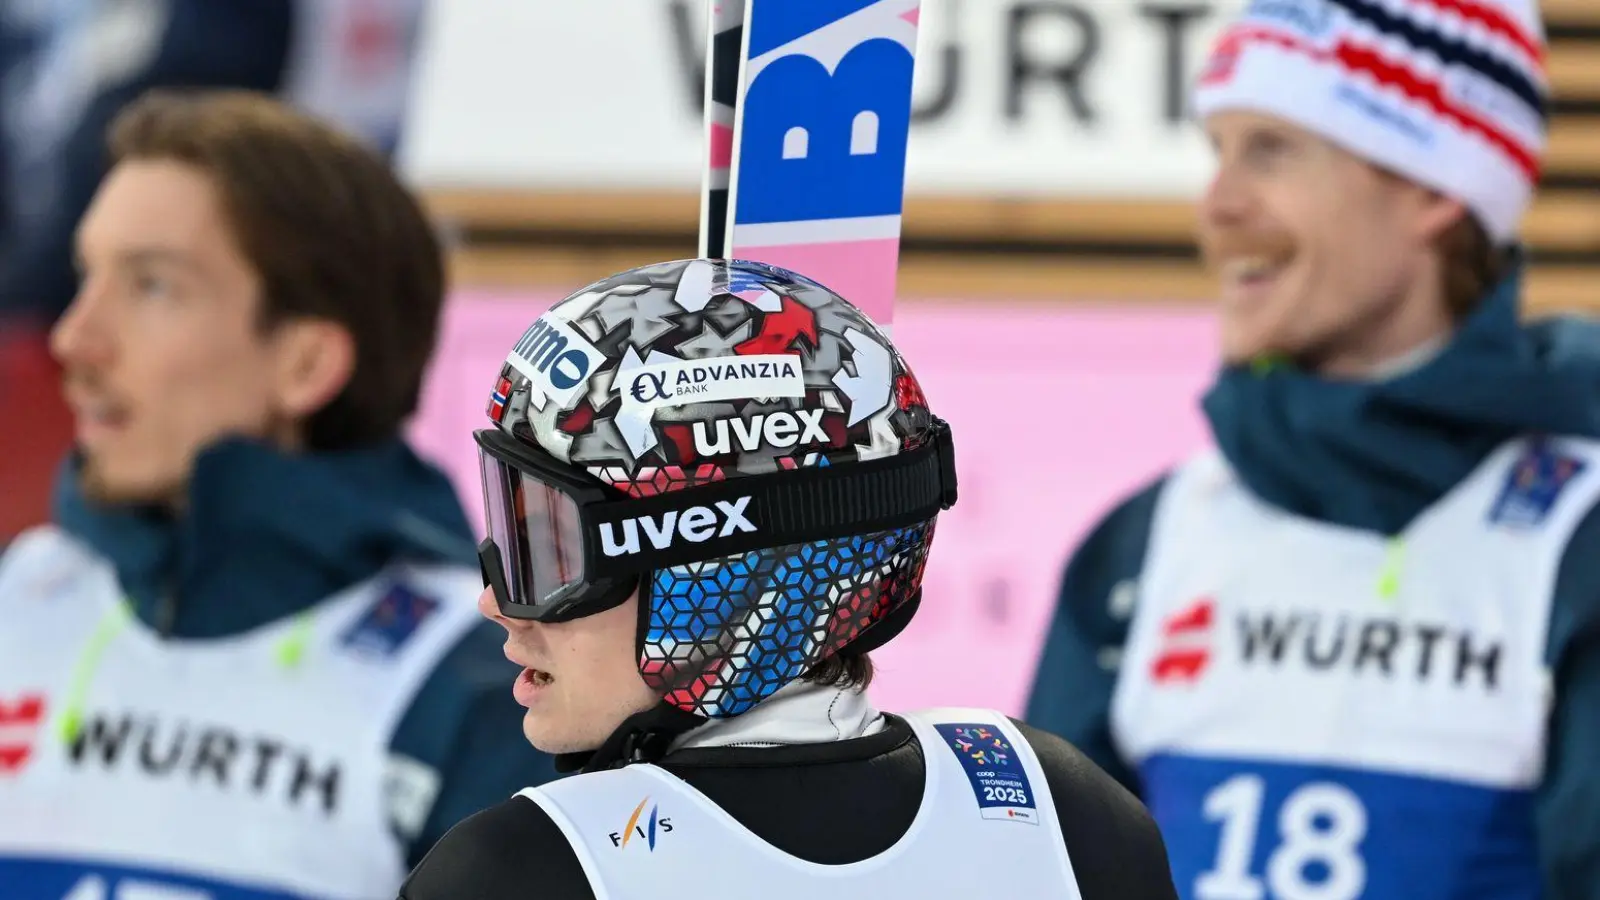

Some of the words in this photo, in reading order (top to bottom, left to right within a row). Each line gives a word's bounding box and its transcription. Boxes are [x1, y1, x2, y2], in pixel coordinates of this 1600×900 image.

[733, 0, 916, 225] B
[676, 362, 796, 385] ADVANZIA
[676, 384, 709, 396] BANK
[692, 408, 831, 457] uvex
[599, 495, 758, 557] uvex
[980, 779, 1023, 788] TRONDHEIM
[983, 786, 1027, 804] 2025
[1192, 773, 1368, 900] 18
